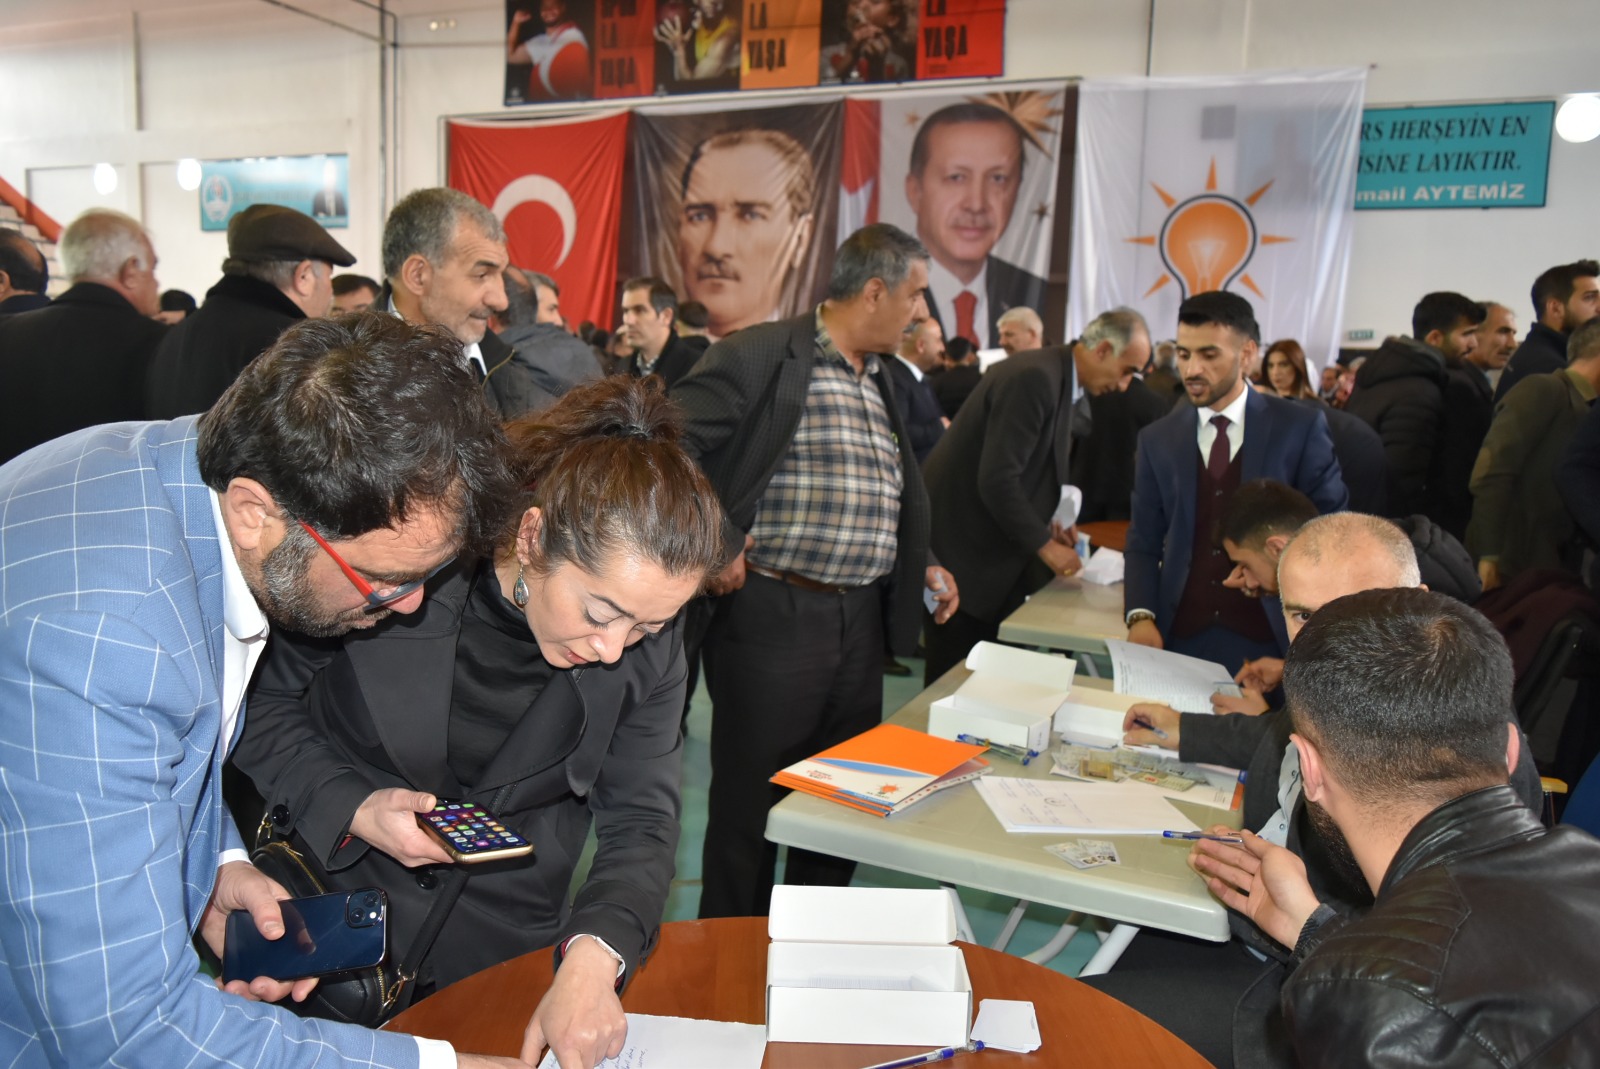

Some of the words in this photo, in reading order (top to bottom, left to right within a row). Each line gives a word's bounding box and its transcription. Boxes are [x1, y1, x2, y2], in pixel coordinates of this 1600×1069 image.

[747, 38, 787, 72] YAŞA
[924, 24, 968, 60] YAŞA
[1360, 120, 1385, 142] RS
[1389, 113, 1494, 143] HERŞEYİN
[1500, 115, 1531, 137] EN
[1357, 148, 1411, 174] İSİNE
[1416, 150, 1521, 173] LAYIKTIR.
[1356, 187, 1406, 202] mail
[1413, 181, 1526, 201] AYTEMİZ
